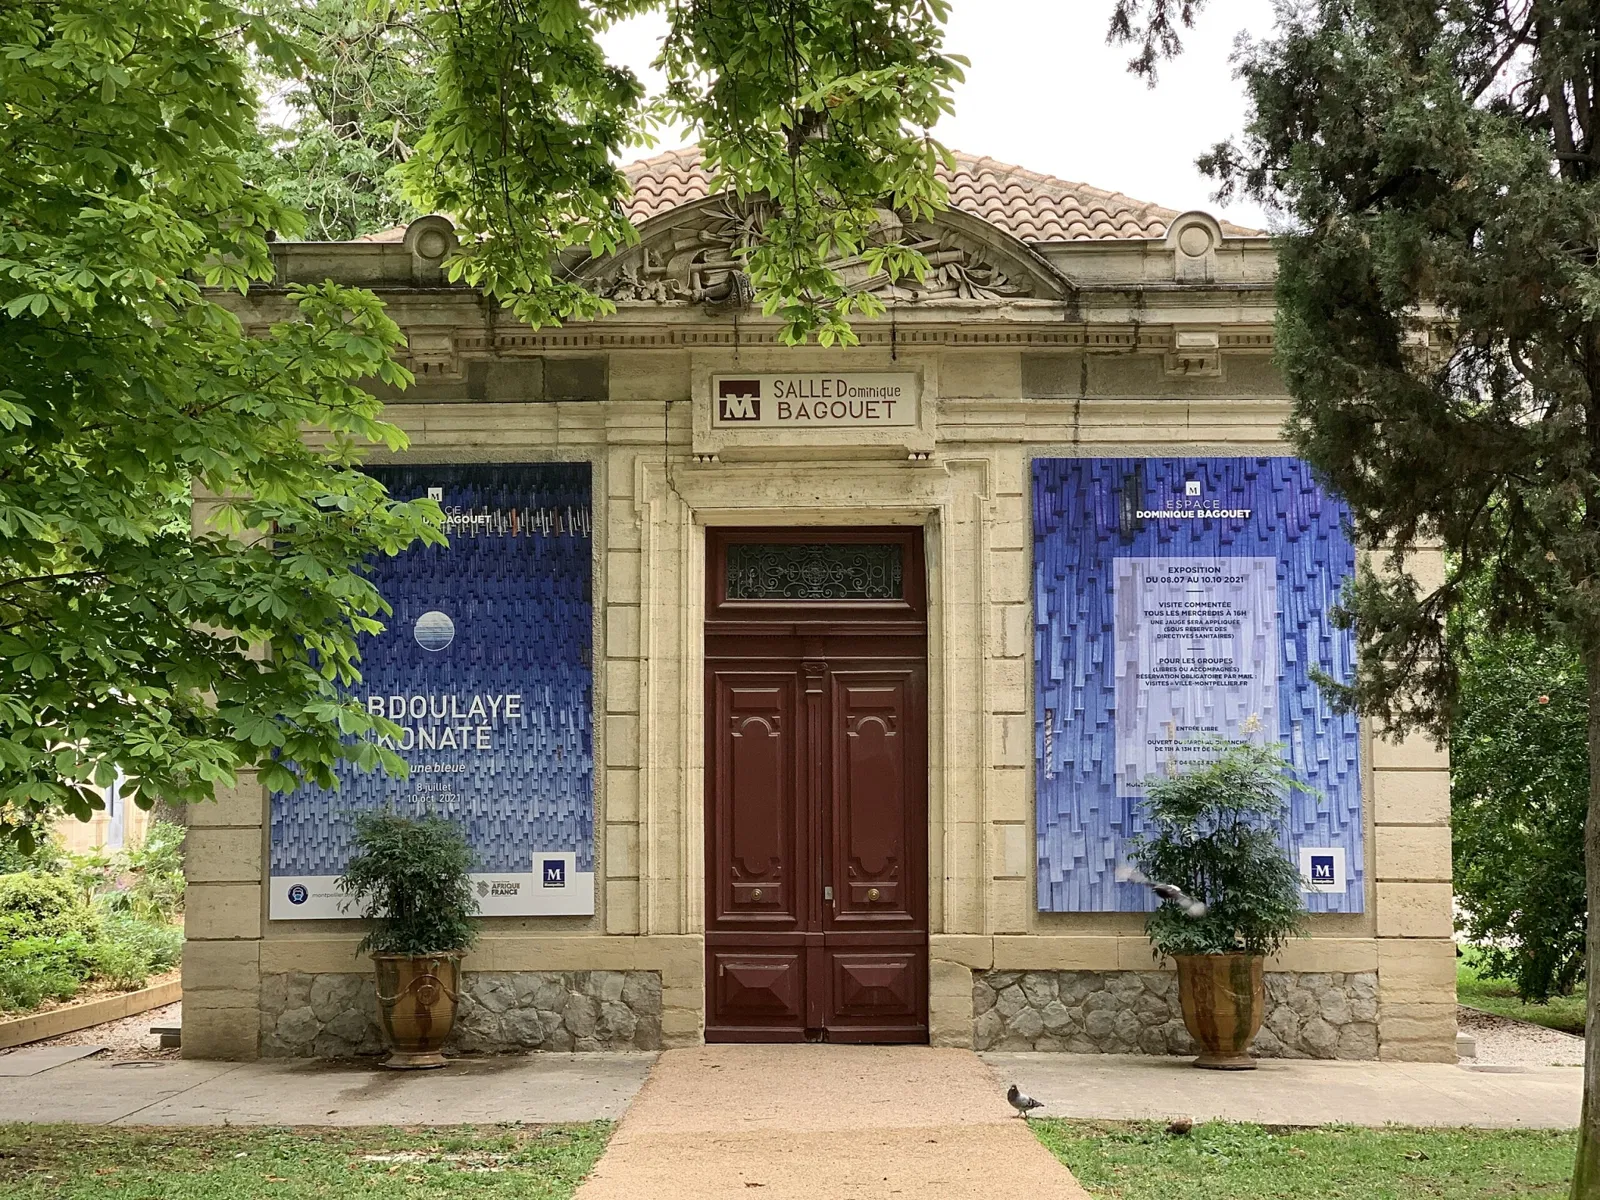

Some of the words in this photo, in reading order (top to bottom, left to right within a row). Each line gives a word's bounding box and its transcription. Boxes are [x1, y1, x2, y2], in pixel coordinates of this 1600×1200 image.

[773, 379, 832, 399] SALLE
[837, 379, 901, 400] Dominique
[777, 400, 897, 420] BAGOUET
[1166, 499, 1220, 509] ESPACE
[1136, 510, 1194, 519] DOMINIQUE
[1197, 509, 1251, 518] BAGOUET
[440, 515, 491, 524] AGOUET
[1168, 566, 1221, 574] EXPOSITION
[1145, 576, 1158, 584] DU
[1160, 576, 1185, 584] 08.07
[1187, 576, 1199, 584] AU
[1201, 576, 1222, 584] 10.10
[1223, 576, 1244, 584] 2021
[1226, 609, 1232, 617] À
[377, 719, 492, 751] KONATÉ
[433, 762, 466, 774] bleue
[416, 783, 423, 793] 8
[424, 782, 452, 794] juillet
[407, 794, 418, 804] 10
[439, 794, 461, 804] 2021
